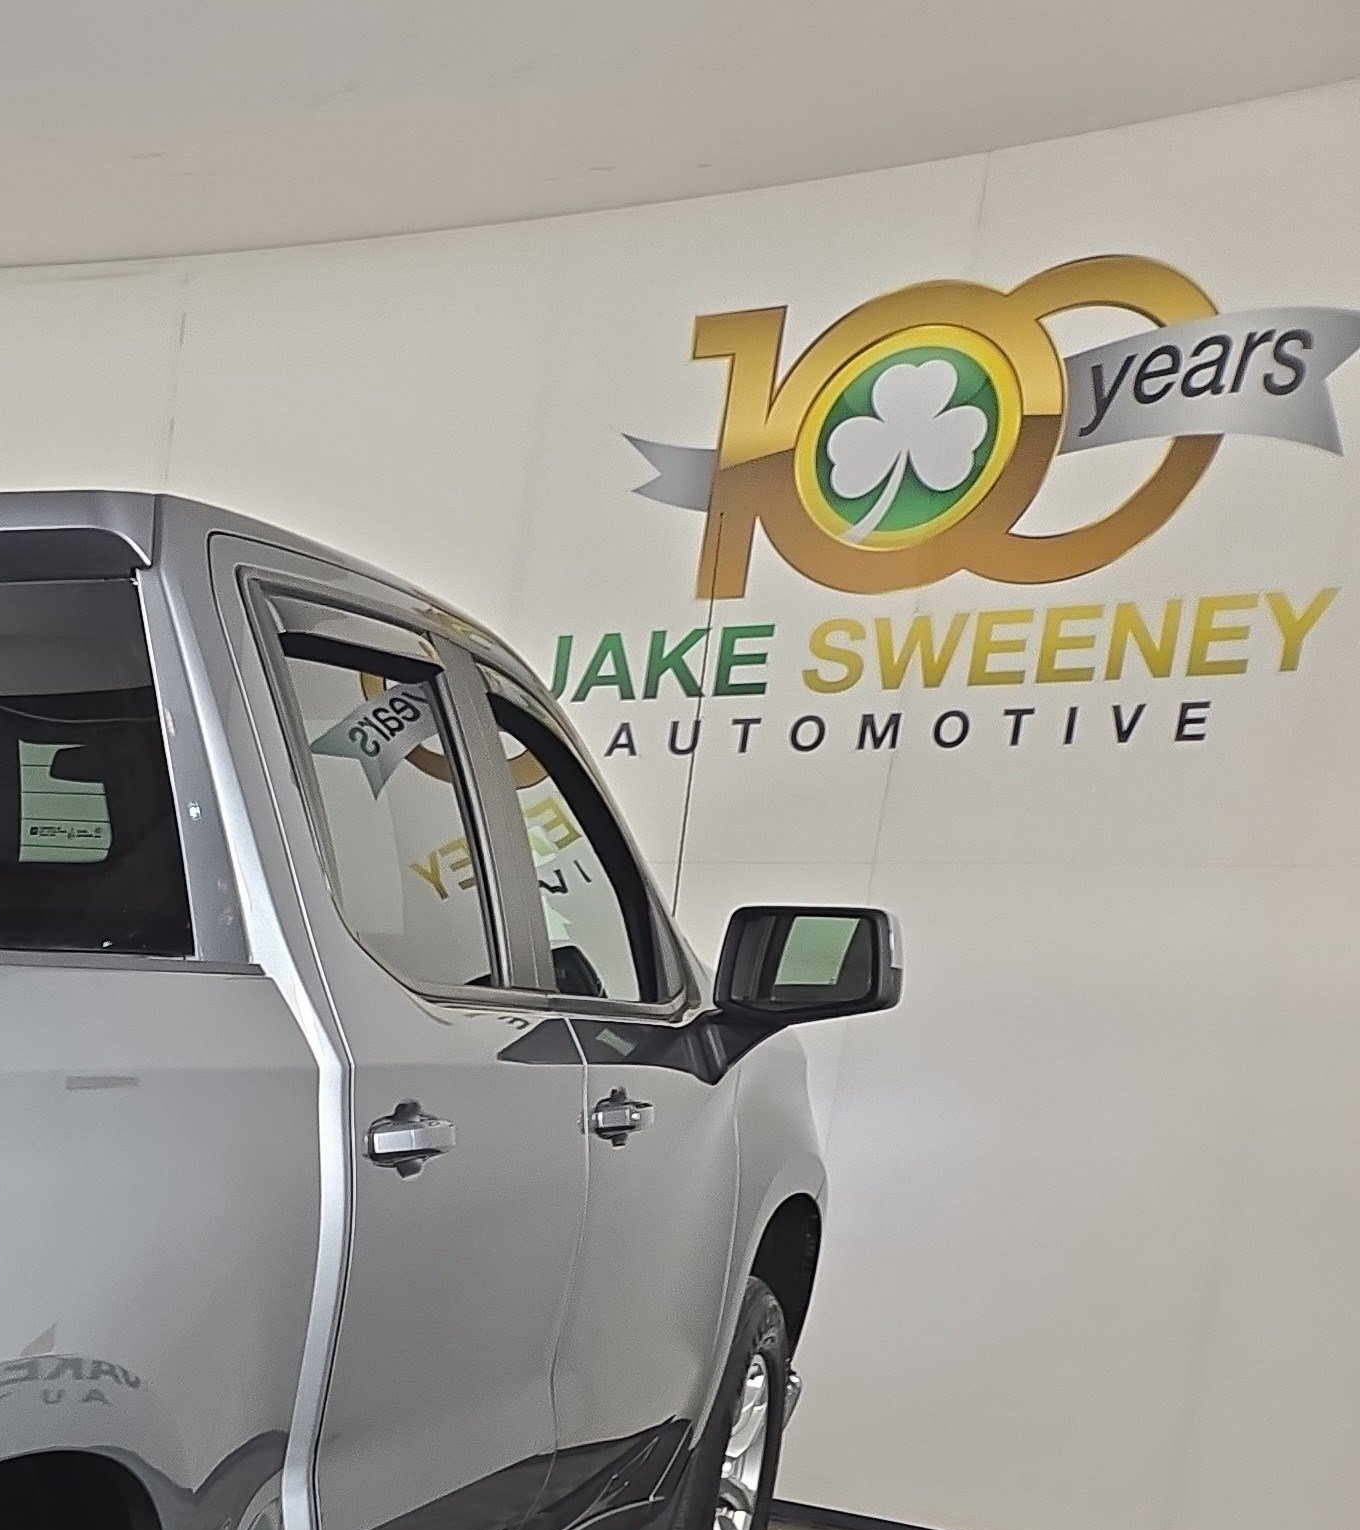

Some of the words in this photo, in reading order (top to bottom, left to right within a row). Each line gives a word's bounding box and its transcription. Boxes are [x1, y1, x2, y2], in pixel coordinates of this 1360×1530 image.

[691, 254, 1221, 600] 100
[1079, 327, 1314, 437] years
[545, 623, 776, 703] JAKE
[801, 586, 1342, 695] SWEENEY
[605, 700, 1210, 757] AUTOMOTIVE
